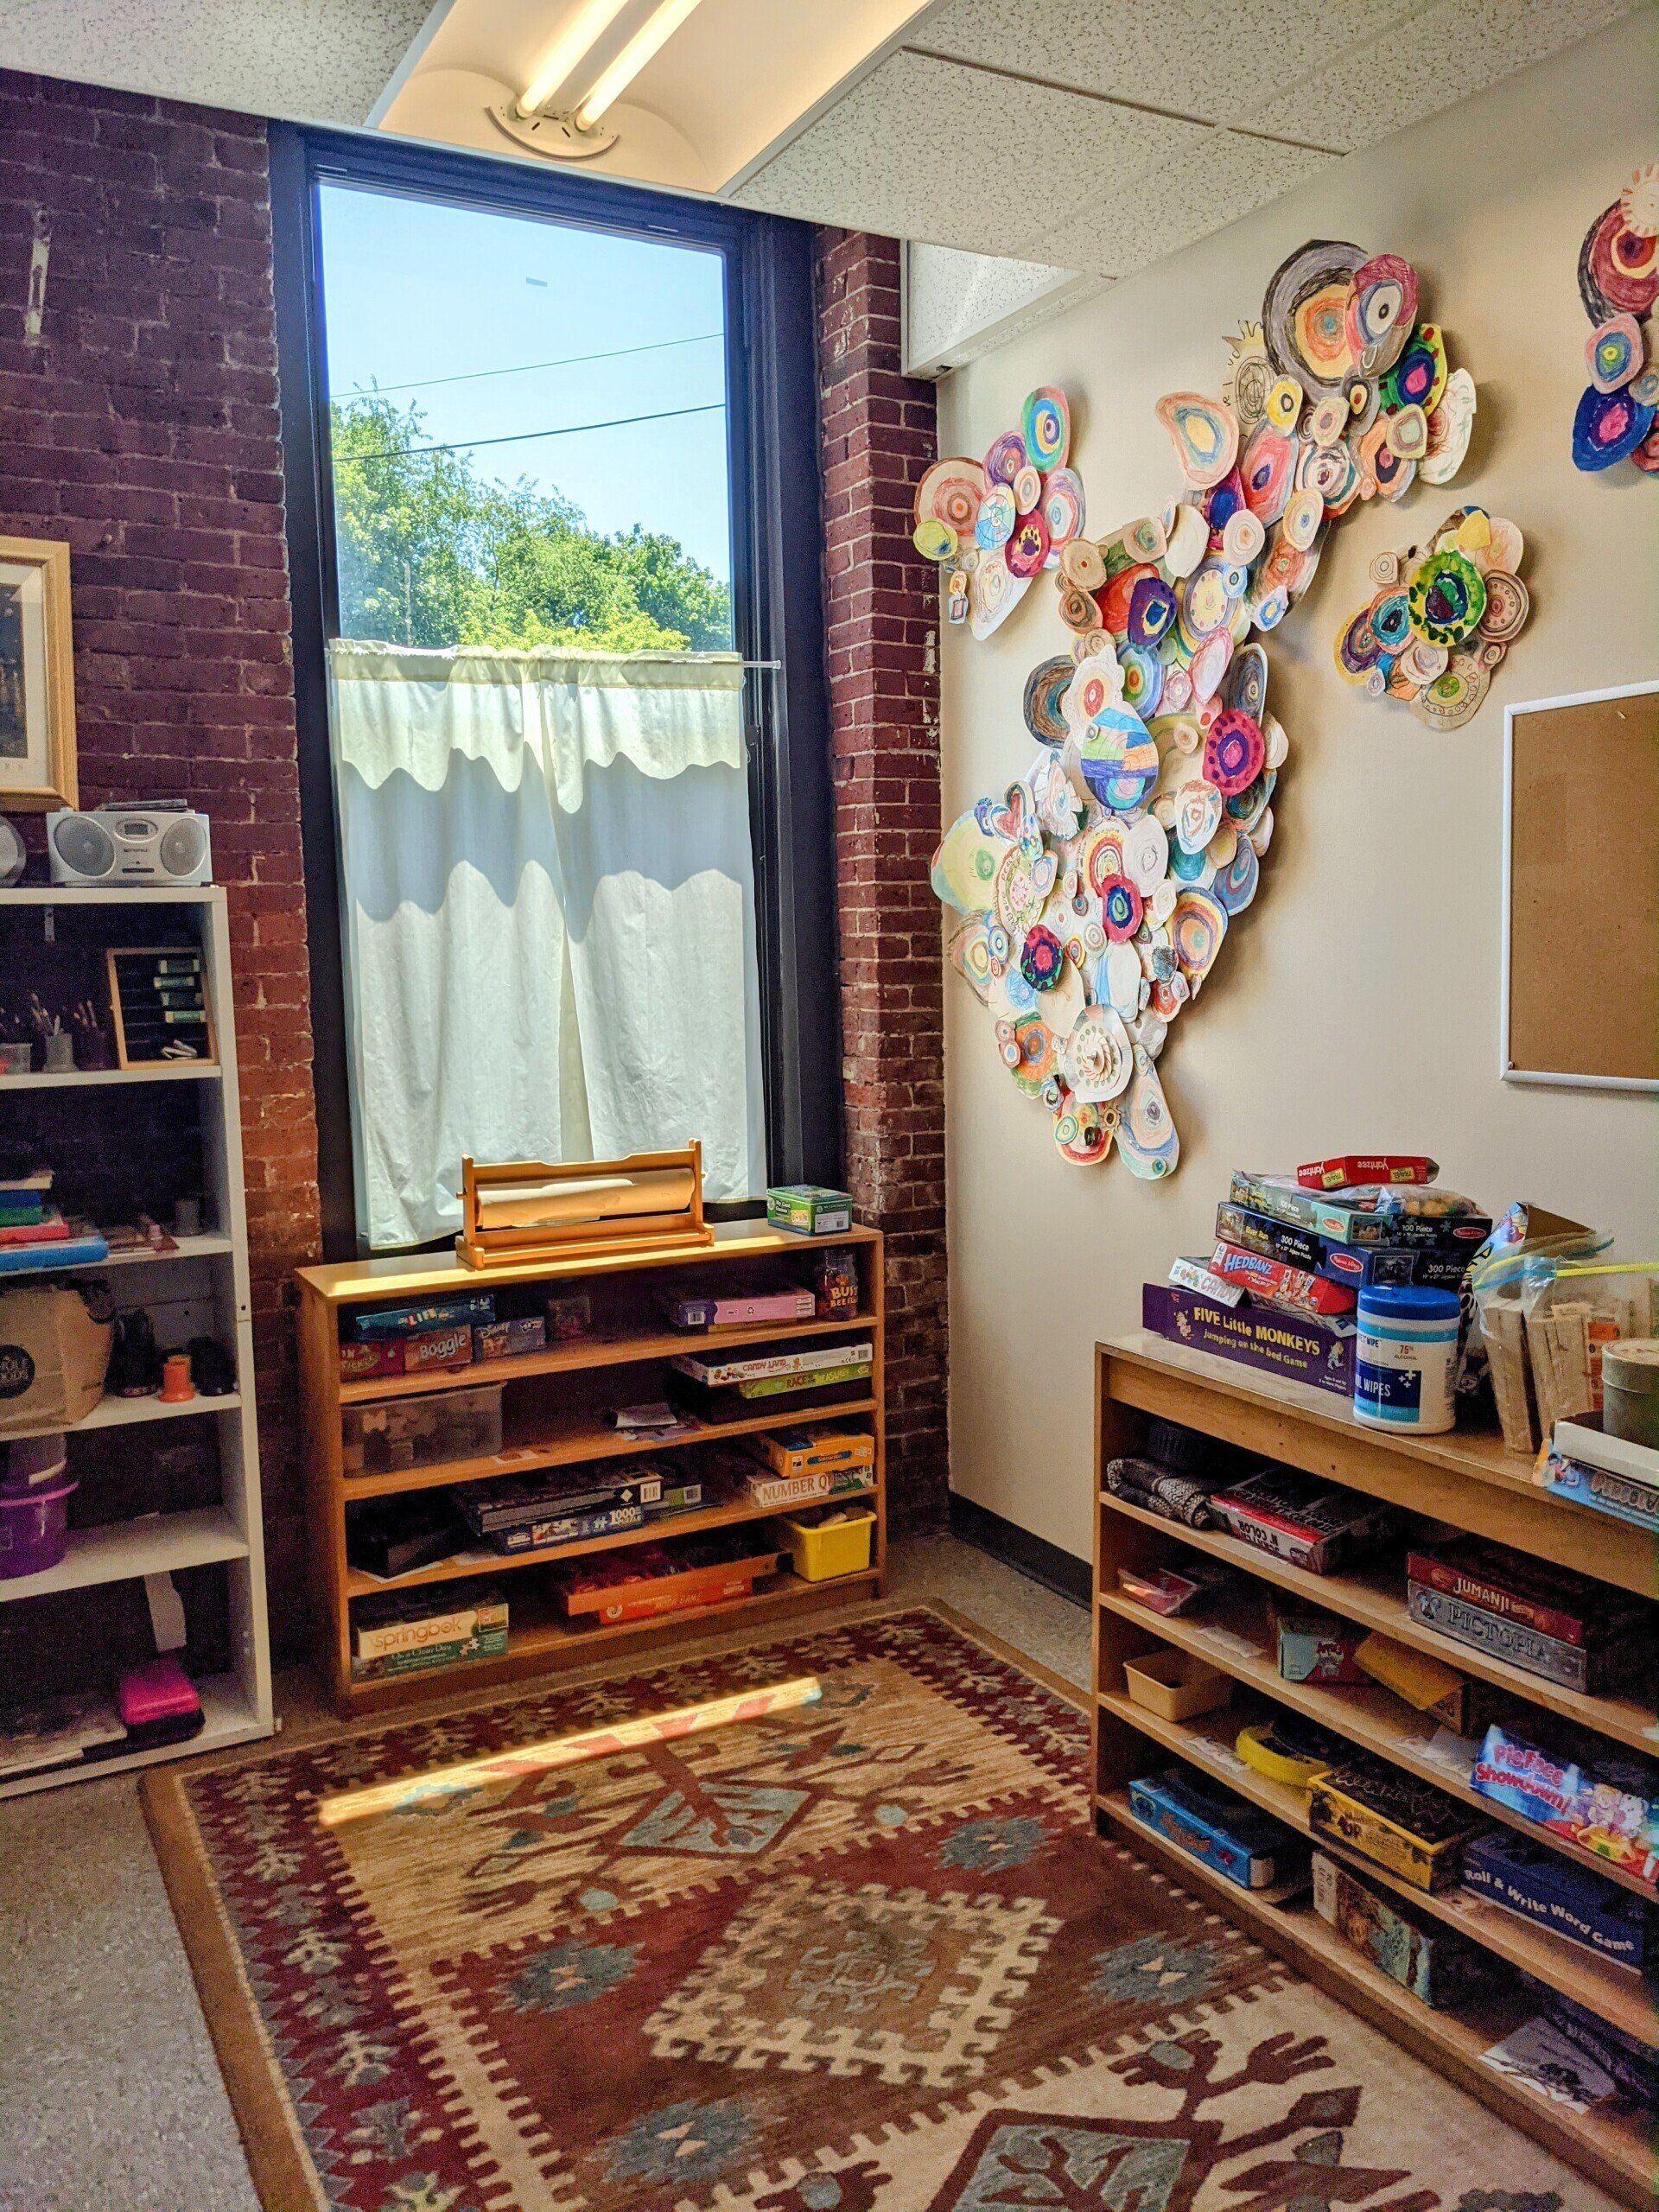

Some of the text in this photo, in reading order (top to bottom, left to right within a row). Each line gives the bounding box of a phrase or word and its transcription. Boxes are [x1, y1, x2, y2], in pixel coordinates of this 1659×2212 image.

[1299, 1162, 1325, 1177] Yahtzee
[1357, 1158, 1389, 1170] Yahtzee
[1281, 1235, 1310, 1251] 300 Piece
[1224, 1254, 1273, 1274] HEDBANZ
[1427, 1264, 1444, 1273] 300
[1193, 1306, 1320, 1356] FIVE Little MONKEYS
[419, 1332, 467, 1361] Boggle
[1204, 1328, 1236, 1349] jumping
[1250, 1341, 1264, 1355] the
[1265, 1346, 1282, 1362] bed
[1283, 1355, 1308, 1369] Game
[742, 1359, 787, 1372] CANDY LAND
[1363, 1378, 1391, 1397] WIPES
[762, 1477, 815, 1500] NUMBER
[1237, 1519, 1268, 1544] COLOR
[1452, 1577, 1510, 1612] JUMANJI
[374, 1617, 462, 1651] springbok
[1464, 1869, 1635, 1951] Roll & Write Word Game
